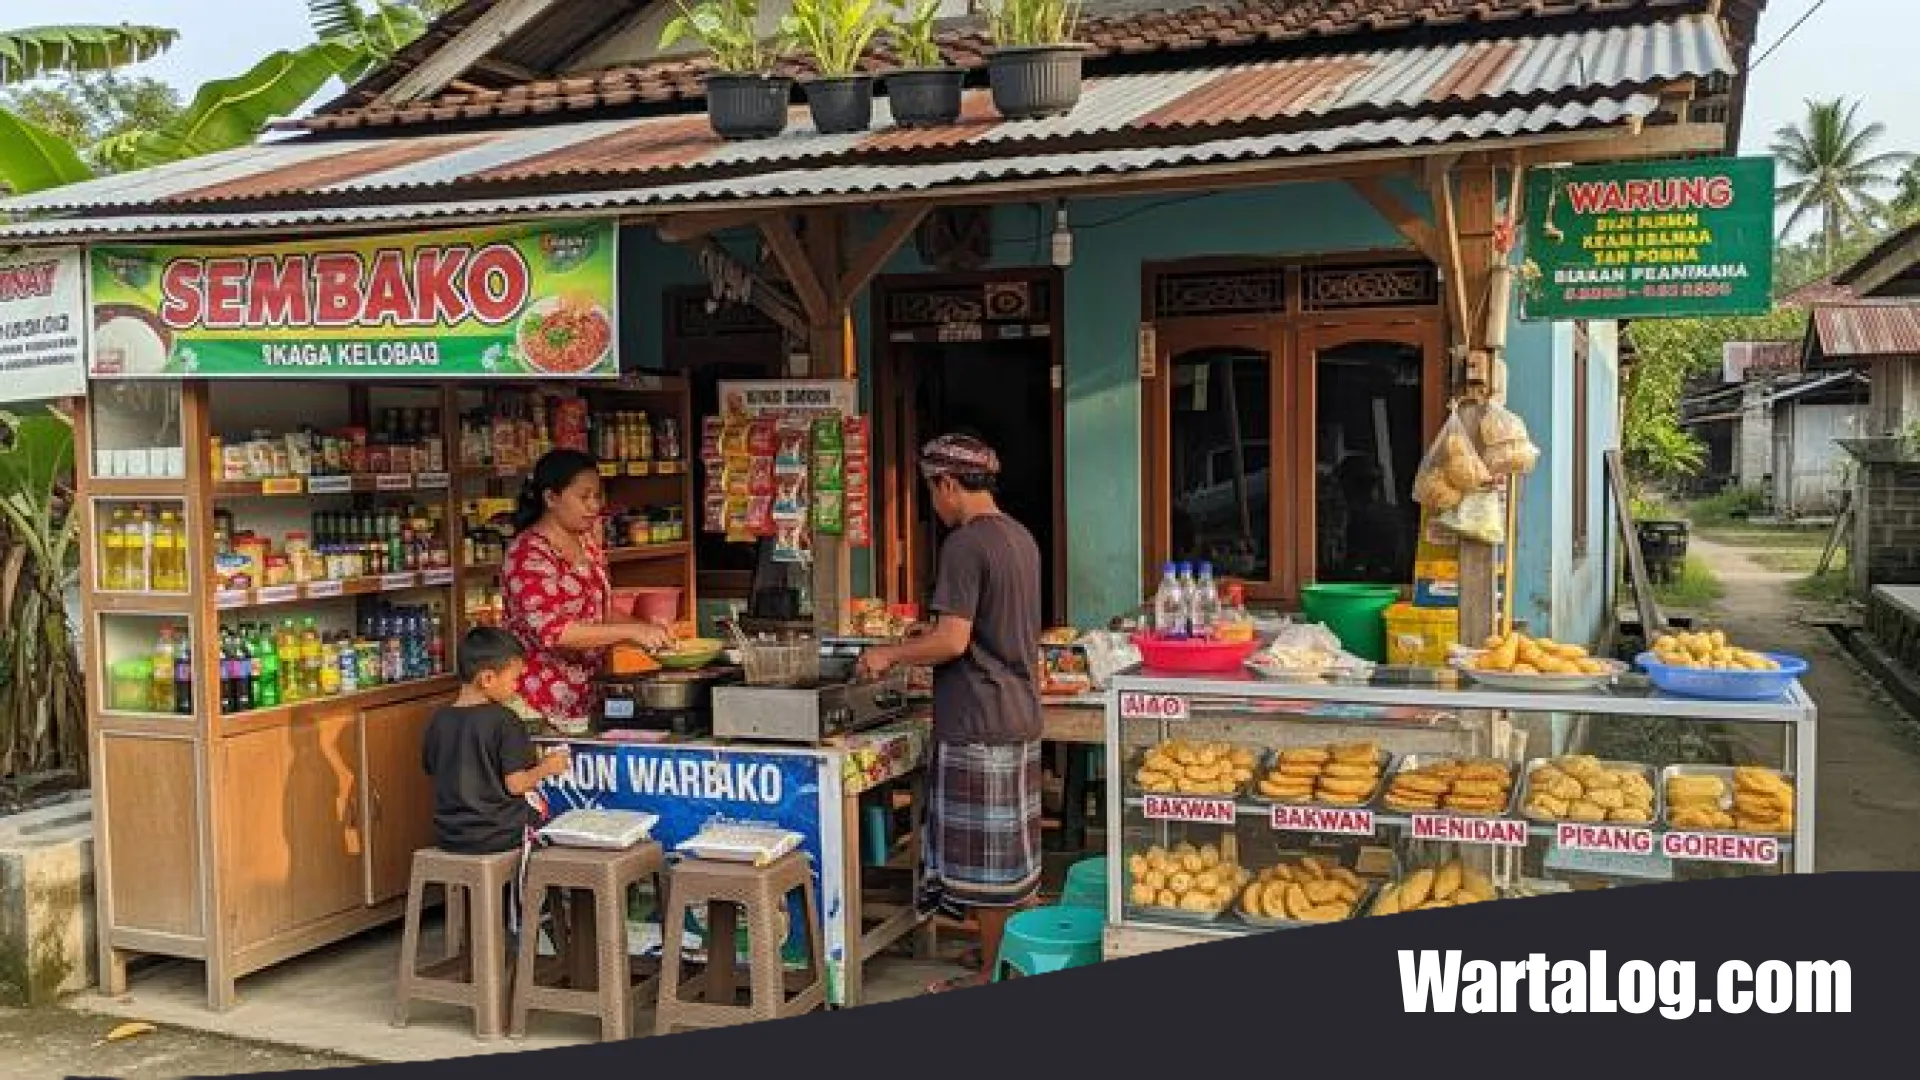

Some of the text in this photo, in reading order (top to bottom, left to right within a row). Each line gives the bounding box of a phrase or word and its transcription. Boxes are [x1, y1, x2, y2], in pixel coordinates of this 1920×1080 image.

[1566, 175, 1734, 214] WARUNG
[161, 243, 530, 329] SEMBAKO
[1146, 800, 1232, 820] BAKWAN
[1274, 808, 1371, 832] BAKWAN
[1414, 817, 1525, 843] MENIDAN
[1665, 836, 1776, 862] GORENG
